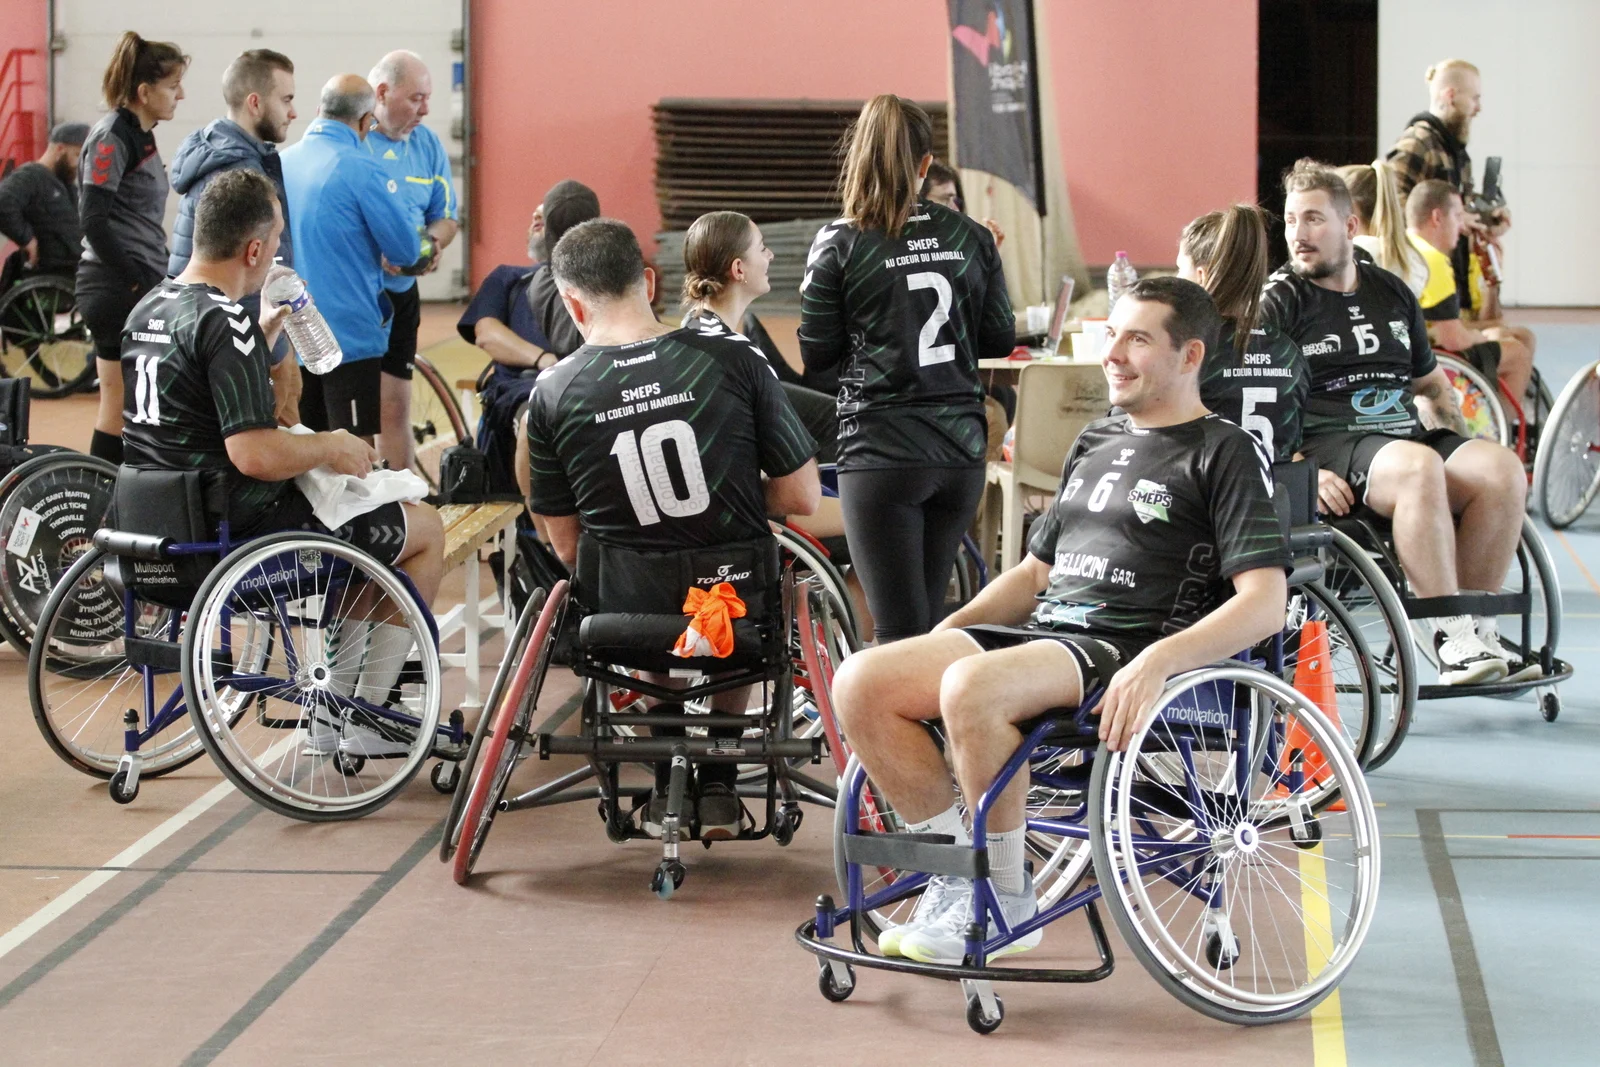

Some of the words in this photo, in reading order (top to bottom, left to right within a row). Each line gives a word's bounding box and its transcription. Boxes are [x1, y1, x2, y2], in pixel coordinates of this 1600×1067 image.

[907, 238, 939, 251] SMEPS
[885, 259, 895, 269] AU
[896, 254, 920, 266] COEUR
[920, 253, 930, 262] DU
[930, 251, 965, 261] HANDBALL
[906, 271, 956, 367] 2
[1351, 323, 1380, 355] 15
[613, 351, 656, 368] hummel
[1244, 353, 1271, 365] SMEPS
[1223, 368, 1231, 378] AU
[1232, 368, 1252, 377] COEUR
[1253, 368, 1262, 377] DU
[1263, 368, 1293, 378] HANDBALL
[132, 354, 160, 426] 11
[621, 382, 661, 402] SMEPS
[595, 412, 606, 424] AU
[607, 405, 635, 420] COEUR
[636, 401, 648, 414] DU
[650, 391, 695, 410] HANDBALL
[1241, 387, 1277, 463] 5
[609, 419, 710, 527] 10
[46, 491, 64, 503] SAINT
[65, 491, 91, 500] MARTIN
[1087, 472, 1122, 512] 6
[1128, 490, 1172, 508] SMEPS
[60, 502, 69, 511] LE
[69, 502, 87, 510] TICHE
[49, 514, 84, 529] THIONVILLE
[58, 527, 87, 540] LONGWY
[16, 555, 41, 594] AZ
[134, 562, 175, 575] Multisport
[143, 576, 179, 584] motivation
[241, 568, 297, 591] motivation
[1111, 568, 1136, 588] SARL
[1166, 706, 1229, 725] motivation
